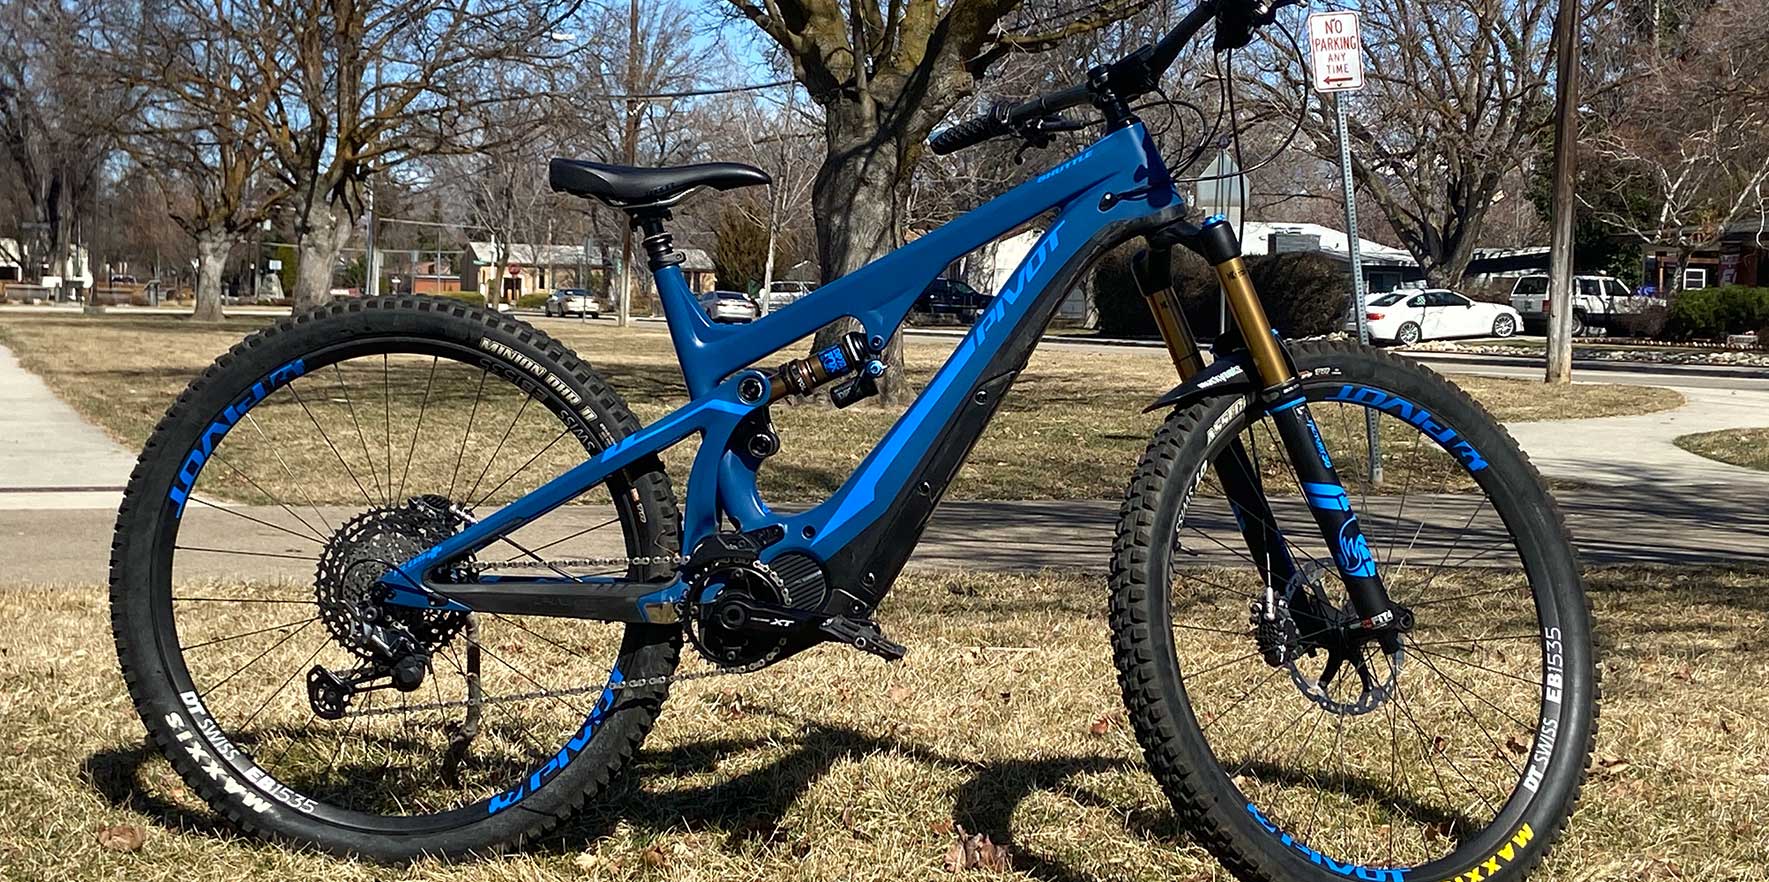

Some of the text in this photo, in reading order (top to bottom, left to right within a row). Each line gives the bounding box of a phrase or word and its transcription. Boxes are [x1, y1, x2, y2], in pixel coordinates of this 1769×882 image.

[1314, 35, 1357, 52] PARKING
[1325, 18, 1343, 34] NO
[1326, 63, 1350, 74] TIME
[1328, 53, 1346, 62] ANY
[1036, 150, 1094, 184] SHUTTLE
[975, 219, 1066, 346] PIVOT
[479, 336, 547, 377] MINION
[545, 372, 582, 406] DHR
[559, 409, 596, 451] SWISS
[1324, 385, 1458, 446] PIVOT
[169, 381, 268, 519] PIVOT
[770, 618, 795, 627] XT
[1523, 627, 1565, 794] DT SWISS EB1535
[165, 712, 273, 814] MAXXIS
[180, 690, 319, 813] DT SWISS EB1535
[1281, 834, 1413, 882] PIVOT
[1441, 822, 1536, 882] MAXX
